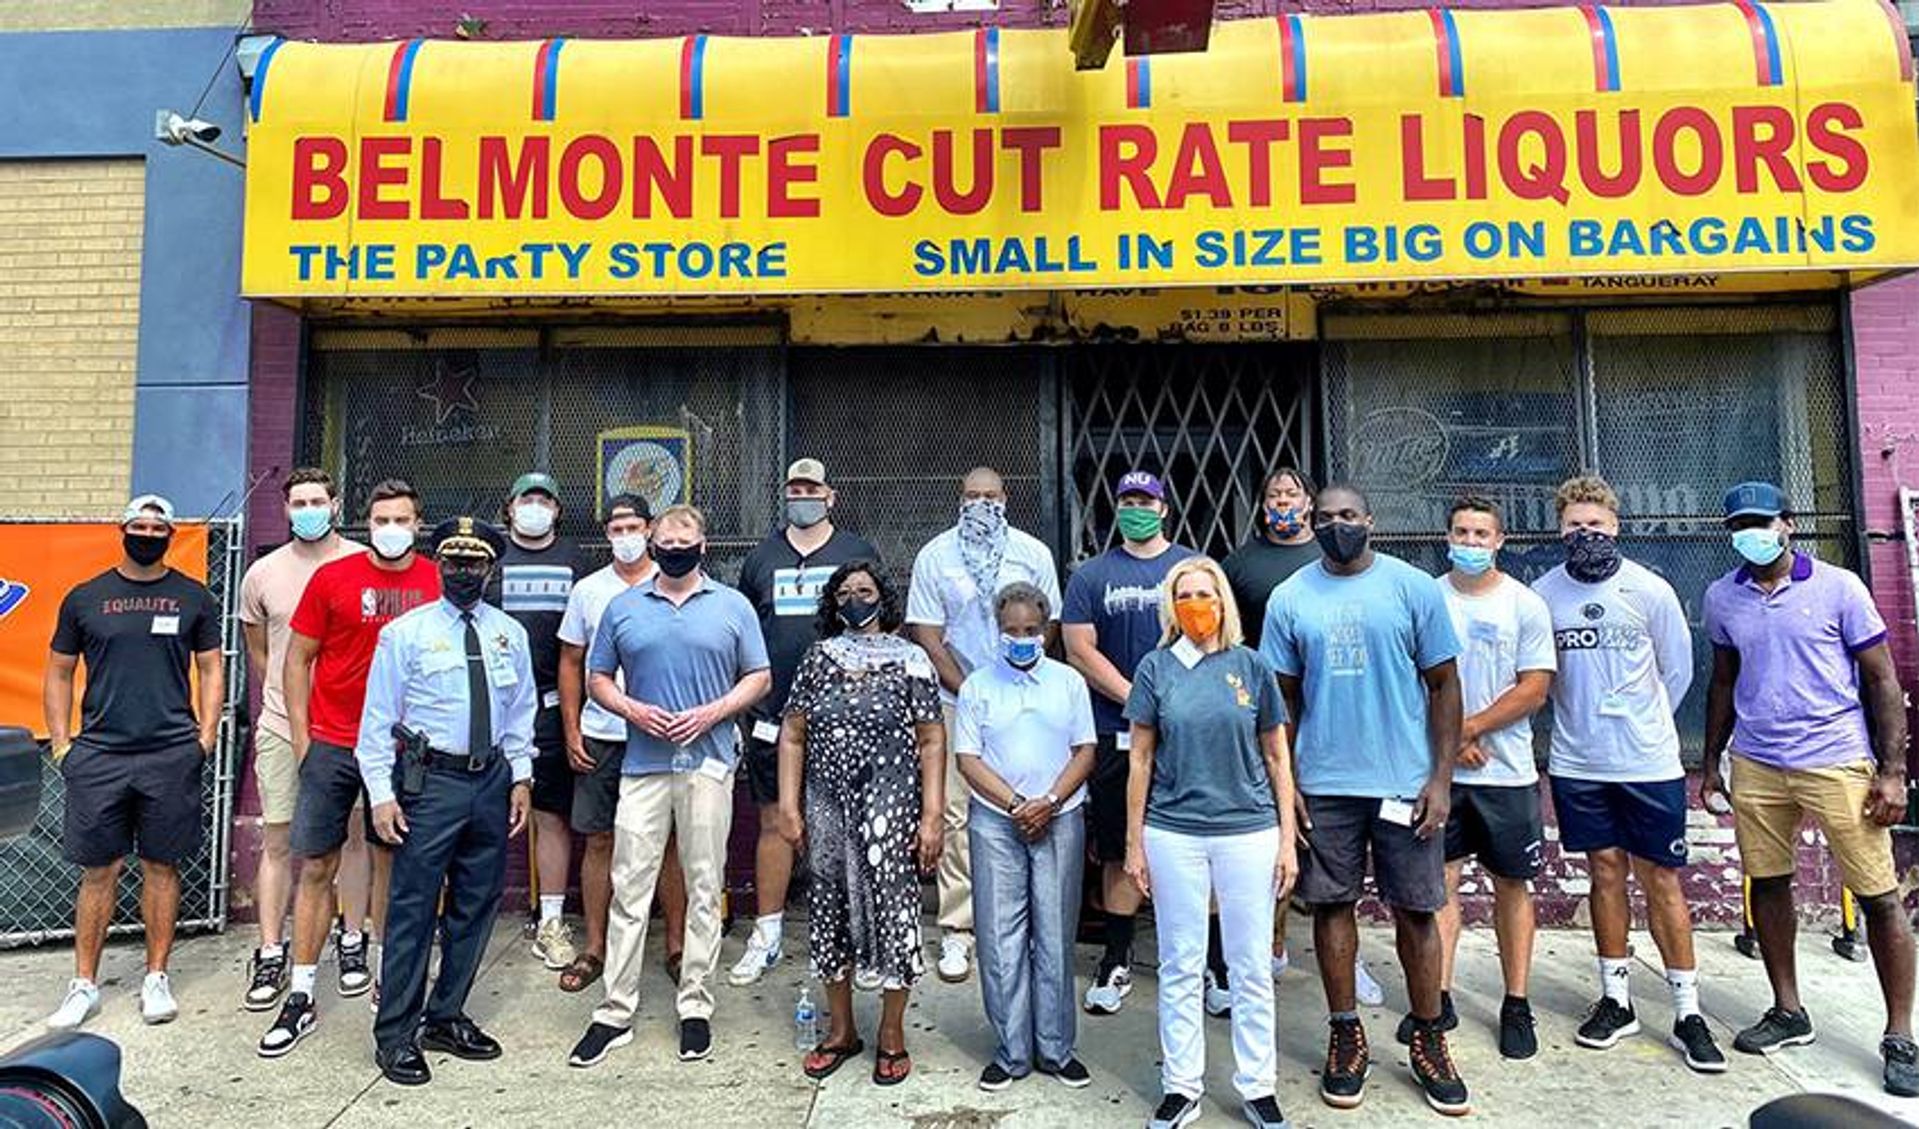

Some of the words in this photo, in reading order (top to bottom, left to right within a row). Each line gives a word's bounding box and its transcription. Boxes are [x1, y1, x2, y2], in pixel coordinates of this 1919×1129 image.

[291, 136, 819, 220] BELMONTE
[864, 127, 1060, 216] CUT
[1100, 118, 1356, 210] RATE
[1402, 103, 1868, 205] LIQUORS
[290, 245, 395, 280] THE
[416, 243, 592, 278] PARTY
[610, 242, 786, 278] STORE
[914, 236, 1097, 275] SMALL
[1119, 234, 1173, 269] IN
[1196, 229, 1322, 267] SIZE
[1345, 225, 1443, 262] BIG
[1464, 221, 1546, 259] ON
[1570, 215, 1876, 256] BARGAINS
[1124, 472, 1151, 485] NU
[1555, 629, 1598, 649] PRO
